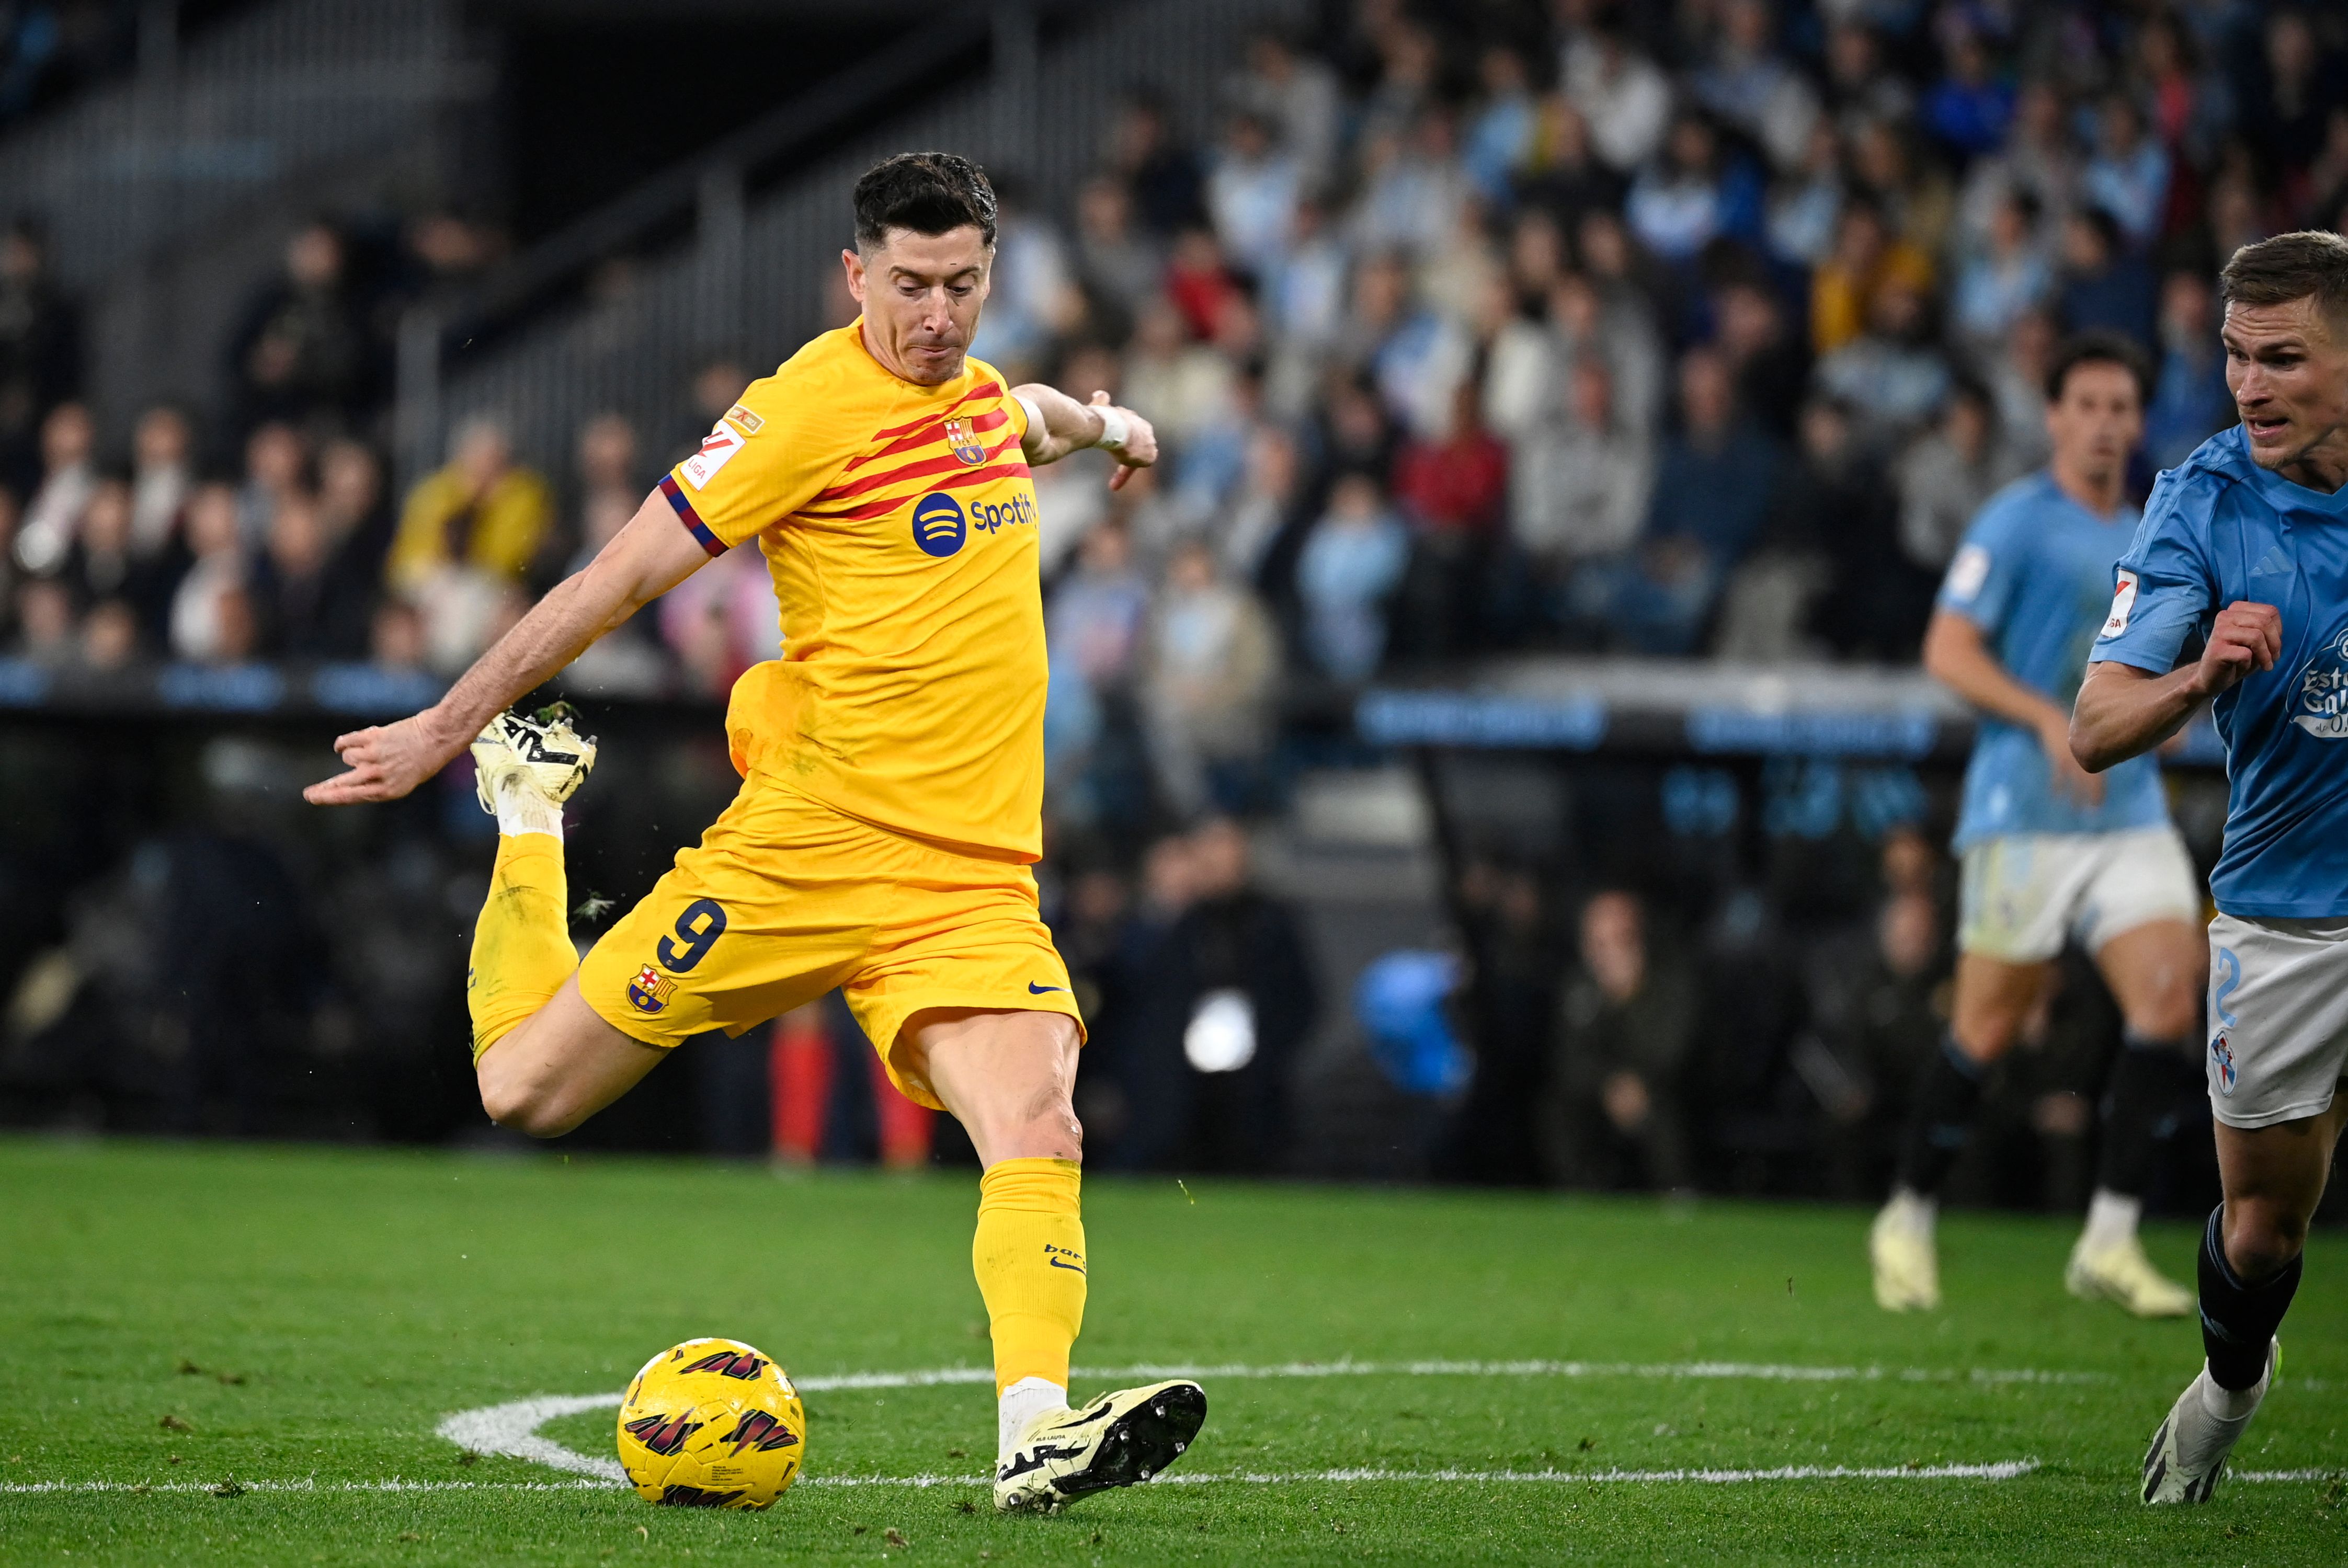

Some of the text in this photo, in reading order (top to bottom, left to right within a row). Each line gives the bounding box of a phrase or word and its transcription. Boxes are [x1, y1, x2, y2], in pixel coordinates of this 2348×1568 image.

[971, 493, 1037, 534] Spotify
[2304, 689, 2348, 715] Gal
[657, 898, 727, 974] 9
[2216, 947, 2241, 1027] 2
